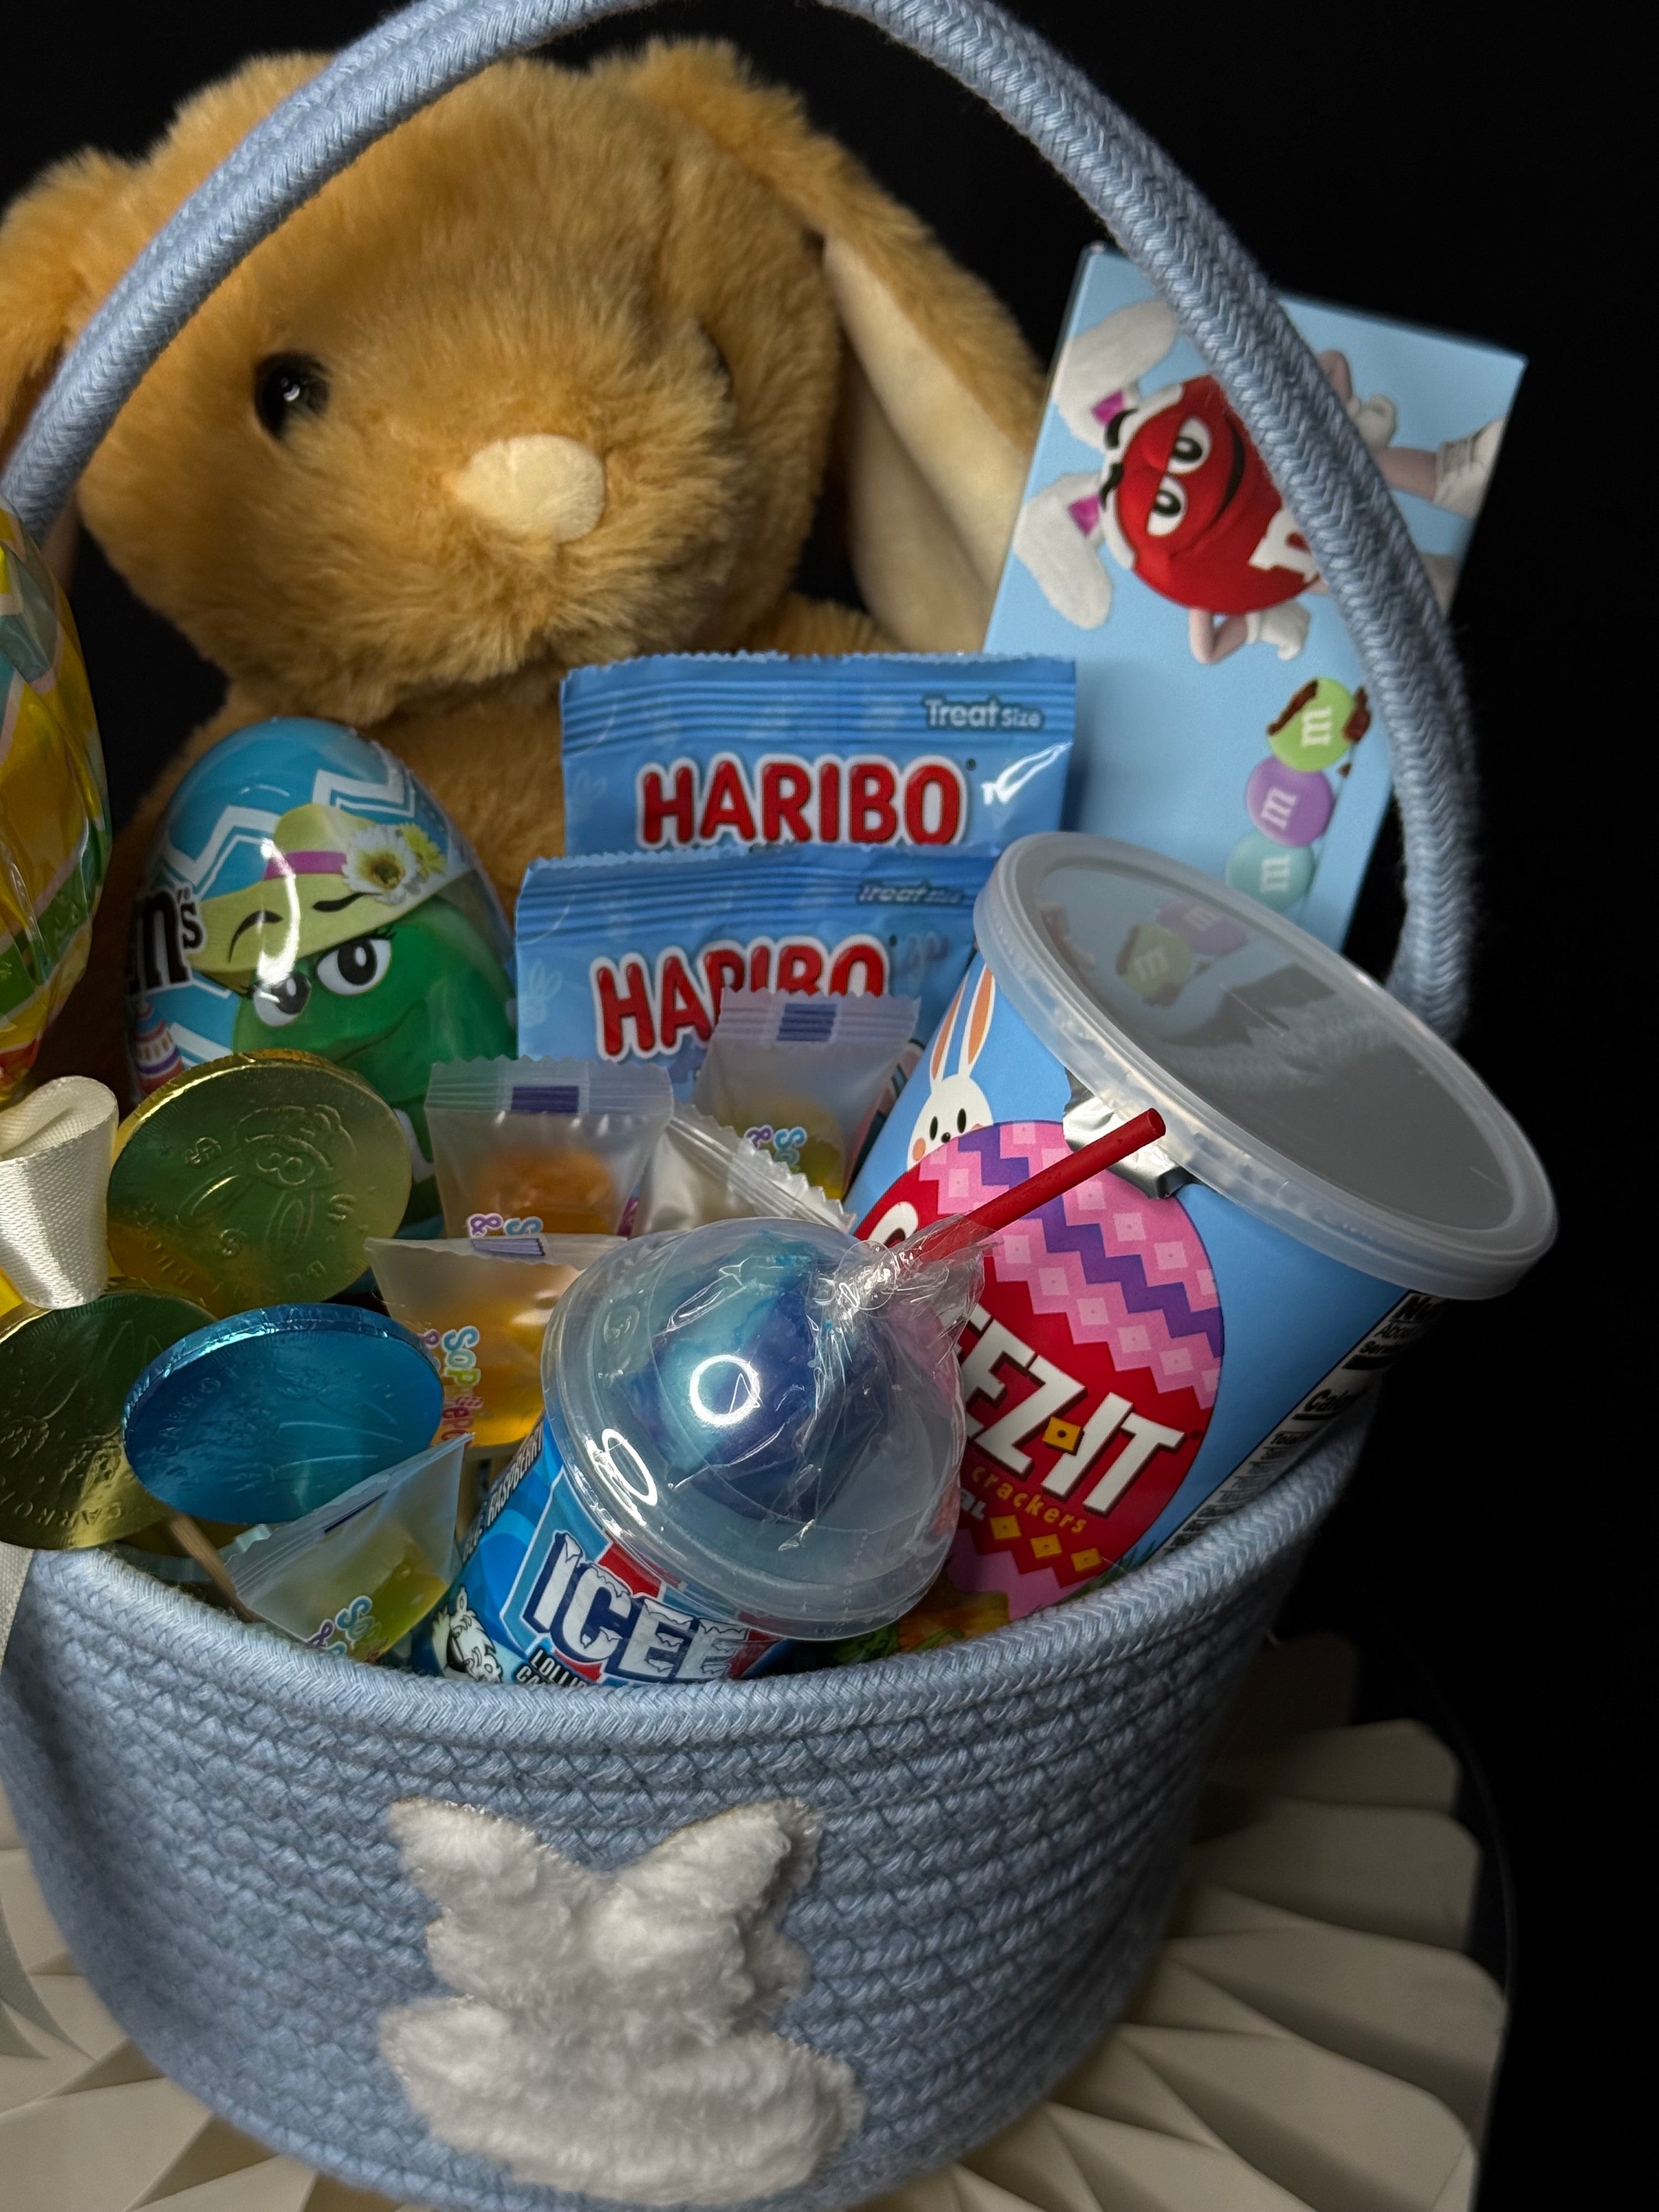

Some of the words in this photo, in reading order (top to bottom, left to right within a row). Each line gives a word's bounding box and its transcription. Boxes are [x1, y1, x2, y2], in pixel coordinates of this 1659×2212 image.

[926, 698, 1001, 726] Treat
[637, 755, 966, 848] HARIBO
[971, 1465, 1087, 1534] crackers
[531, 1532, 751, 1680] ICEE
